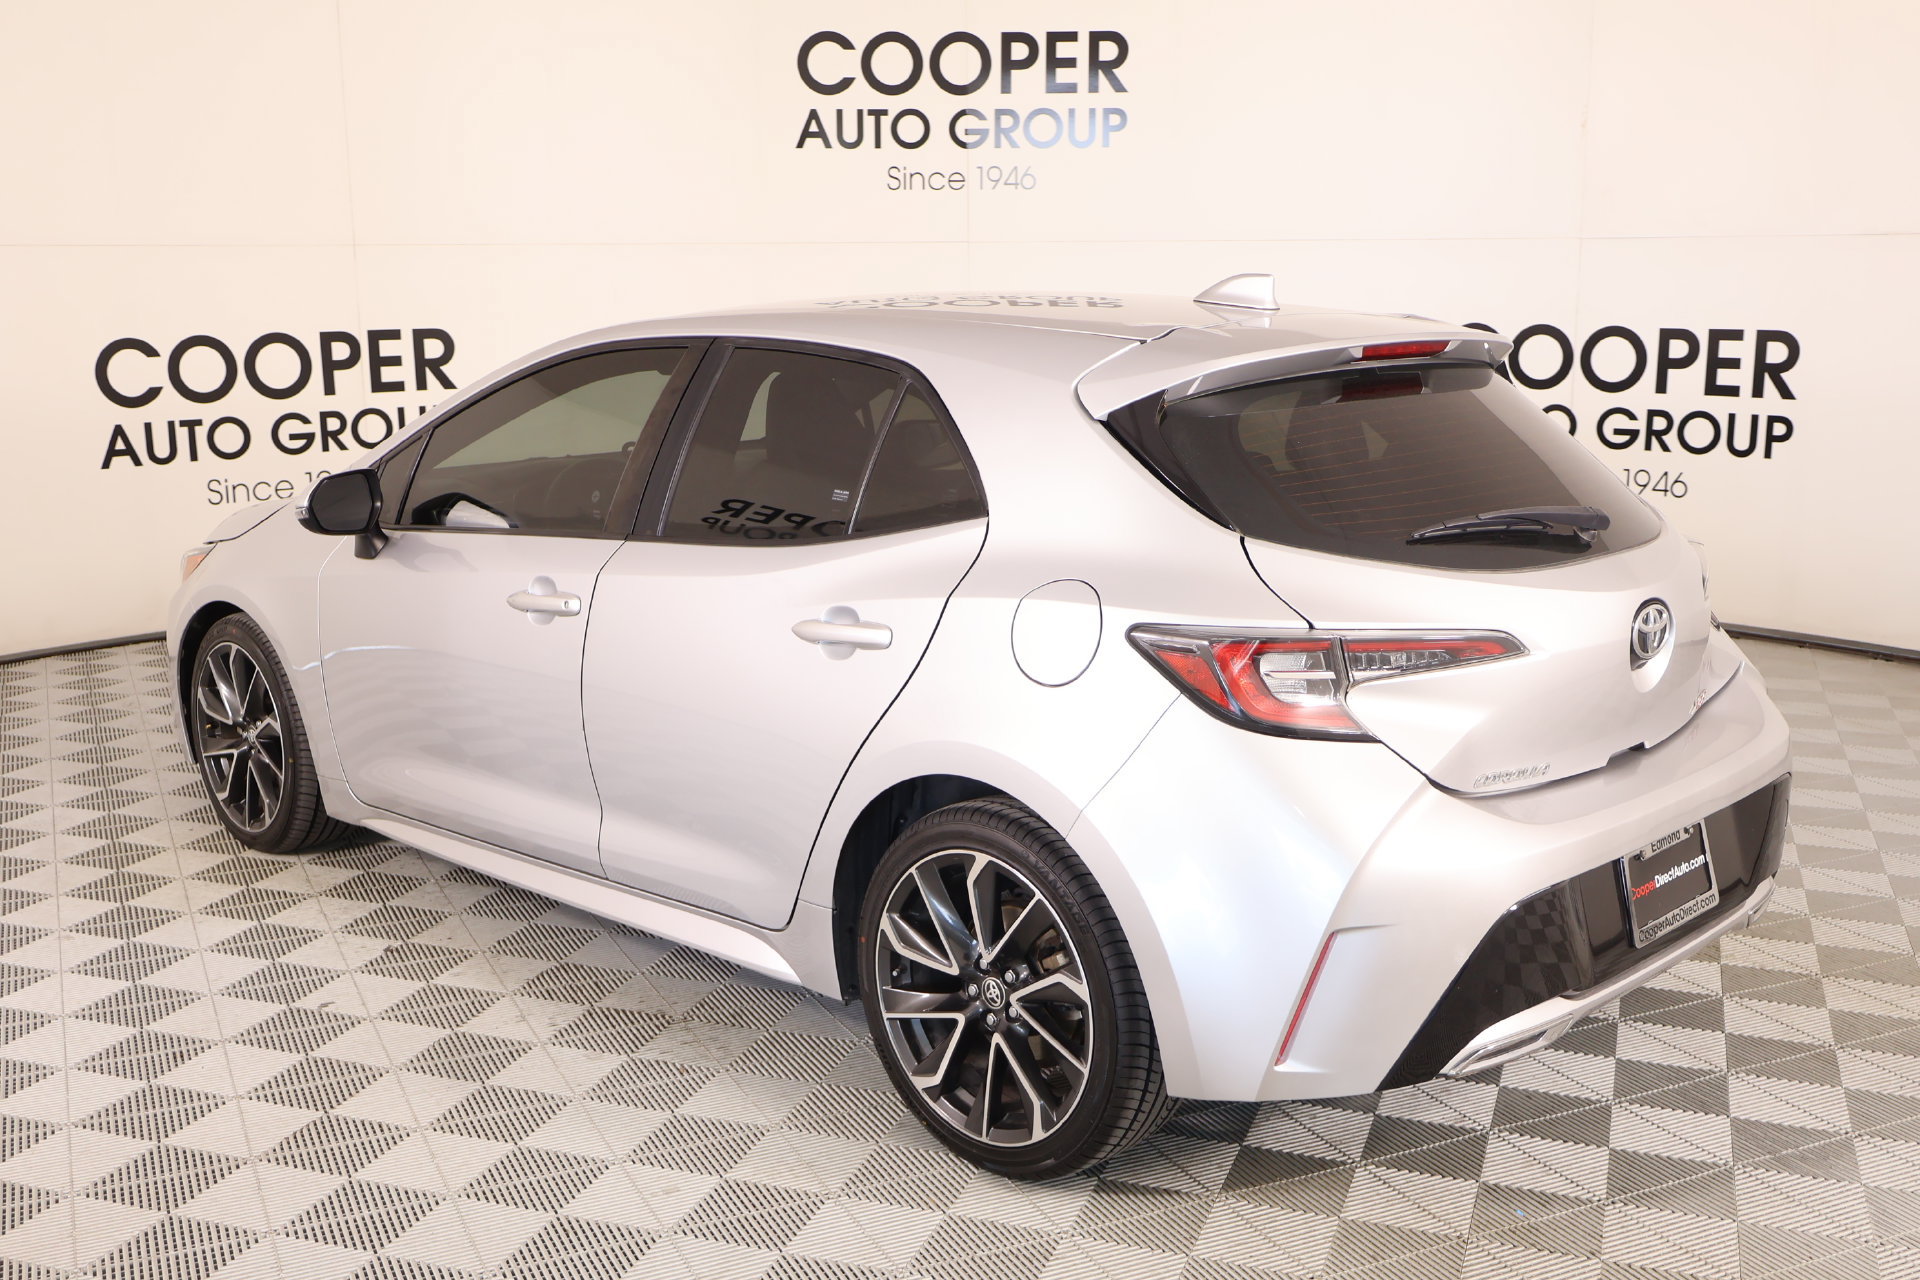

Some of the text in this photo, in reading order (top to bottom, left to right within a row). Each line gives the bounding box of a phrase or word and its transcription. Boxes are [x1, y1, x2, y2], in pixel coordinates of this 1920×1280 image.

[797, 31, 1129, 95] COOPER
[796, 107, 1128, 149] AUTO GROUP
[887, 166, 1037, 190] Since 1946
[95, 328, 458, 408] COOPER
[101, 405, 437, 469] AUTO GRO
[1597, 407, 1794, 459] GROUP
[207, 478, 294, 505] Since
[1623, 469, 1688, 498] 1946
[1639, 893, 1716, 942] CooperAutoDirect.com
